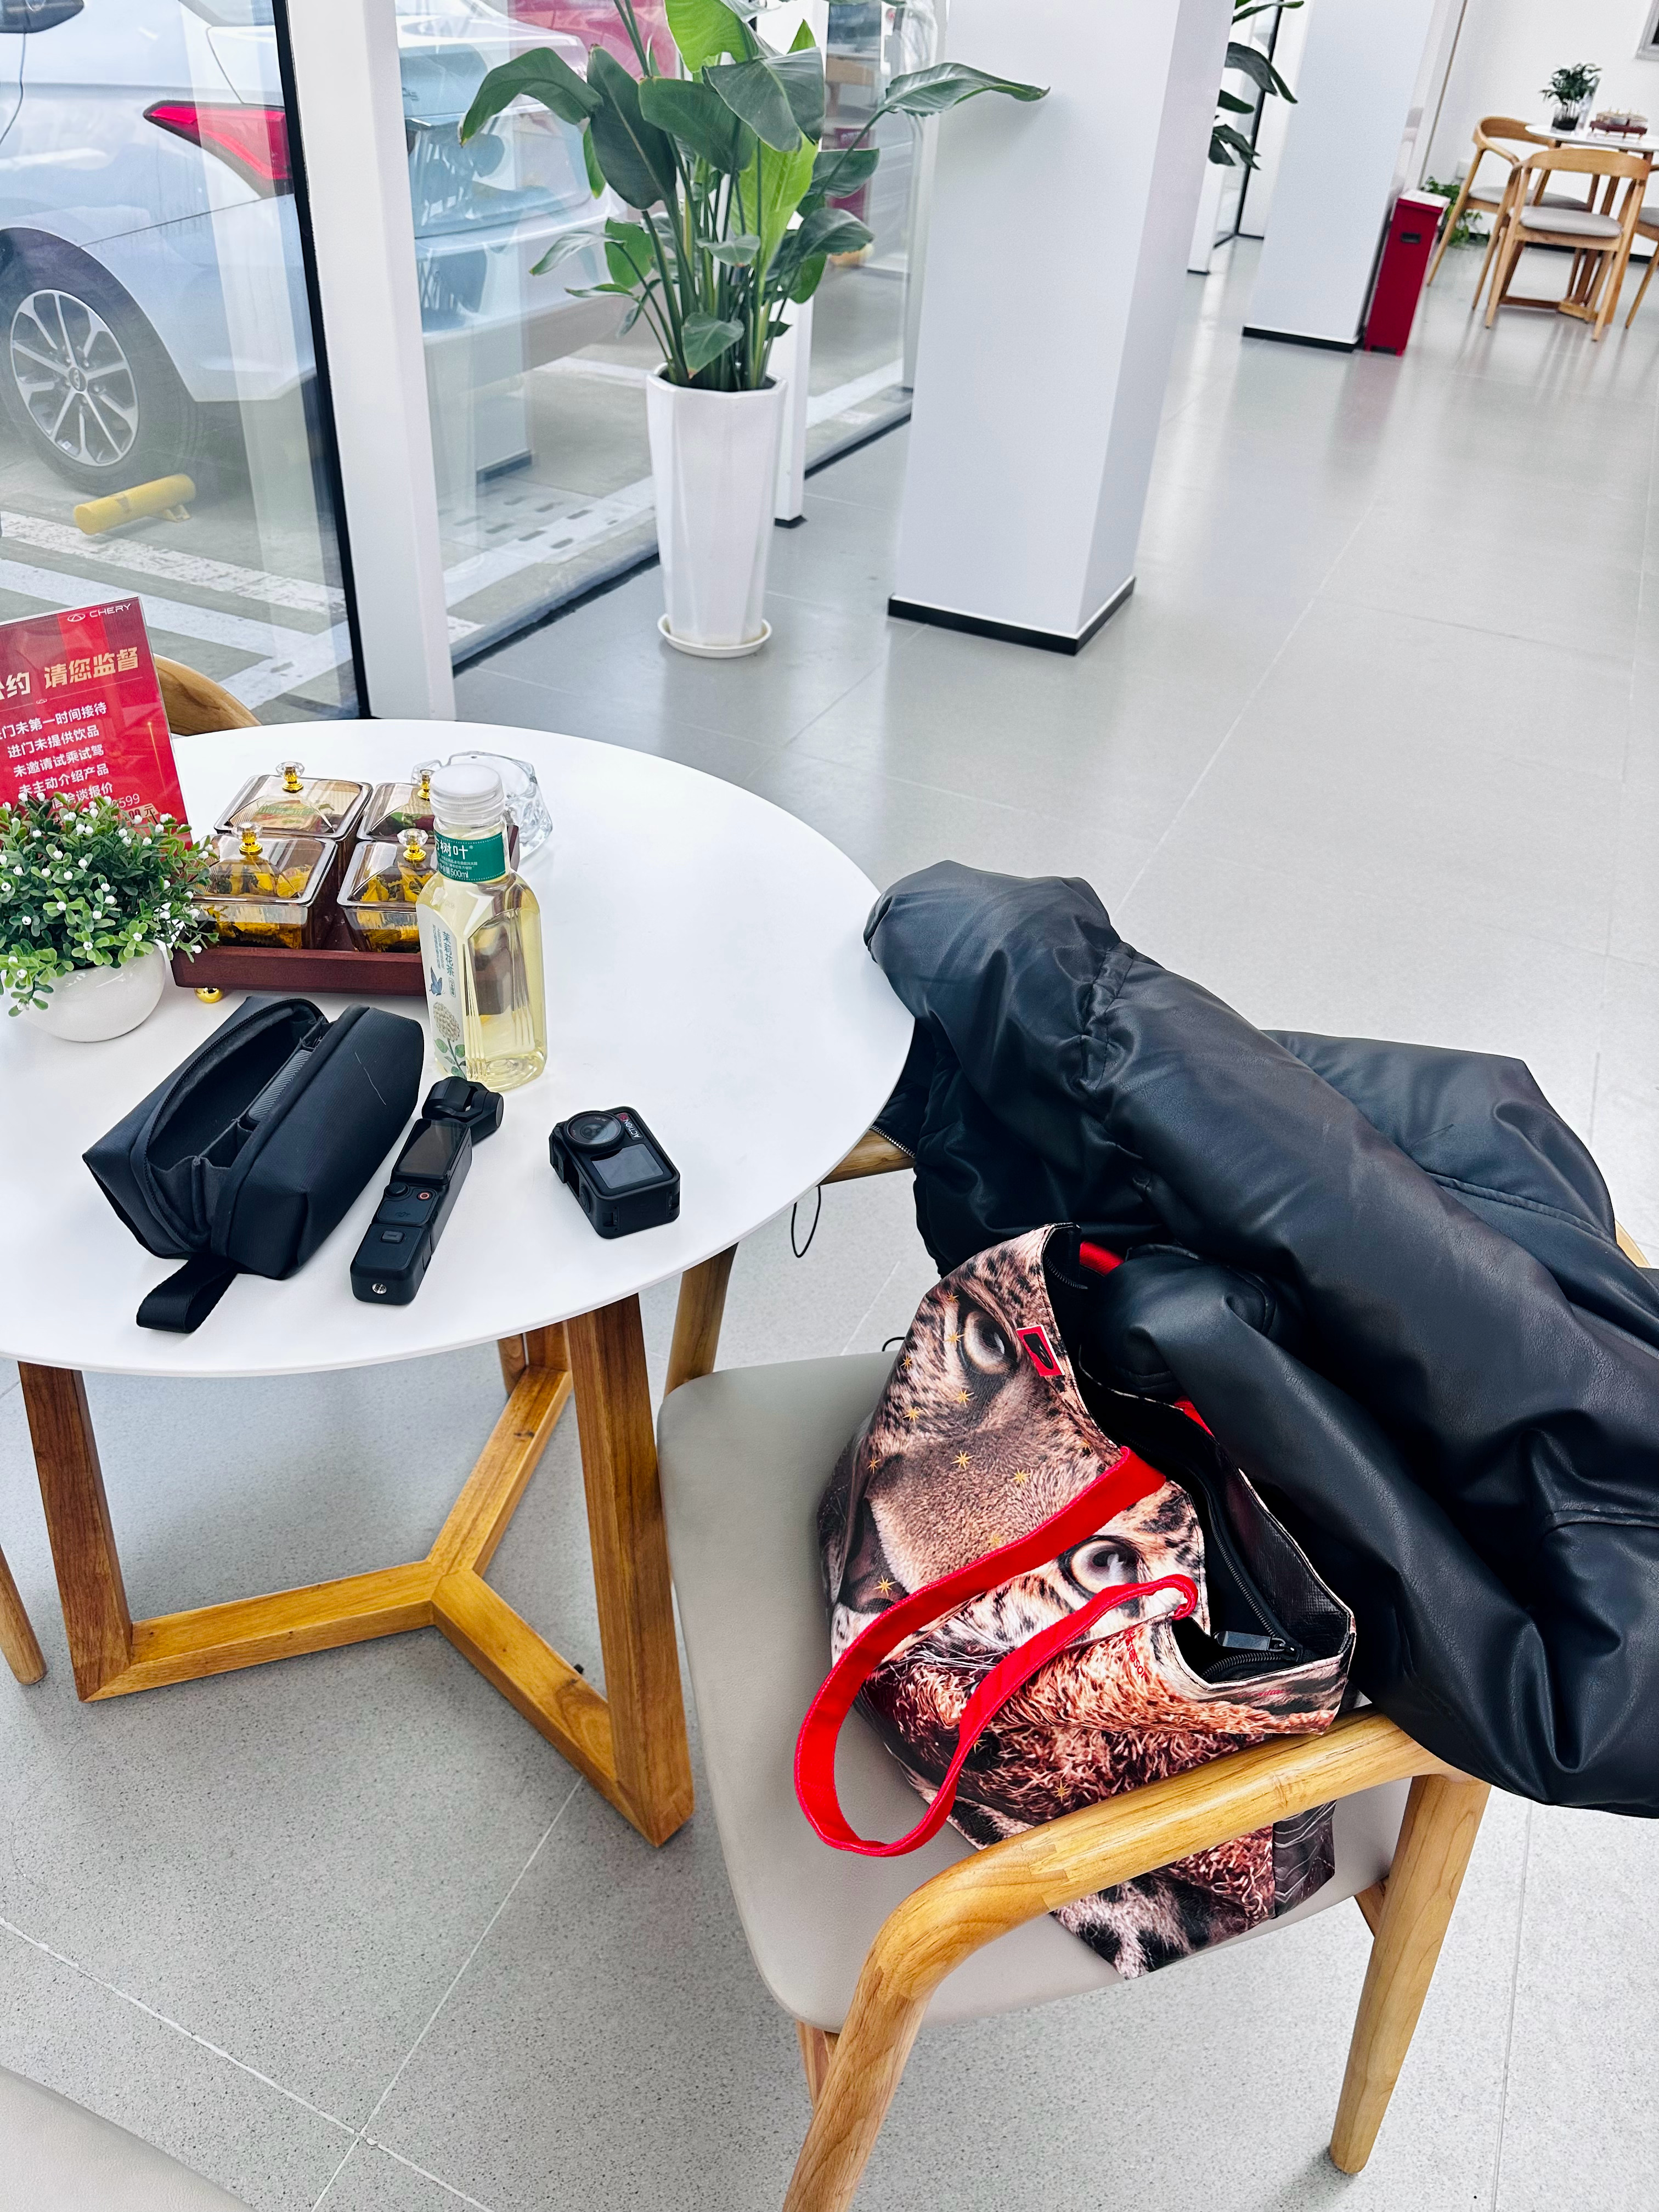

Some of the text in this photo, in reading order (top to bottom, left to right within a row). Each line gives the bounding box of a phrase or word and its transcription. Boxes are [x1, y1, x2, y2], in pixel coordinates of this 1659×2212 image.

[89, 603, 131, 618] CHERY
[0, 646, 138, 701] 约 请您监督
[0, 702, 107, 740] 门未第一时间接待
[7, 724, 100, 759] 进门未提供饮品
[13, 744, 104, 778] 未邀请试乘试驾
[19, 763, 109, 795] 未主动介绍产品
[442, 931, 455, 977] 茉莉花茶
[623, 1119, 641, 1138] ACTION
